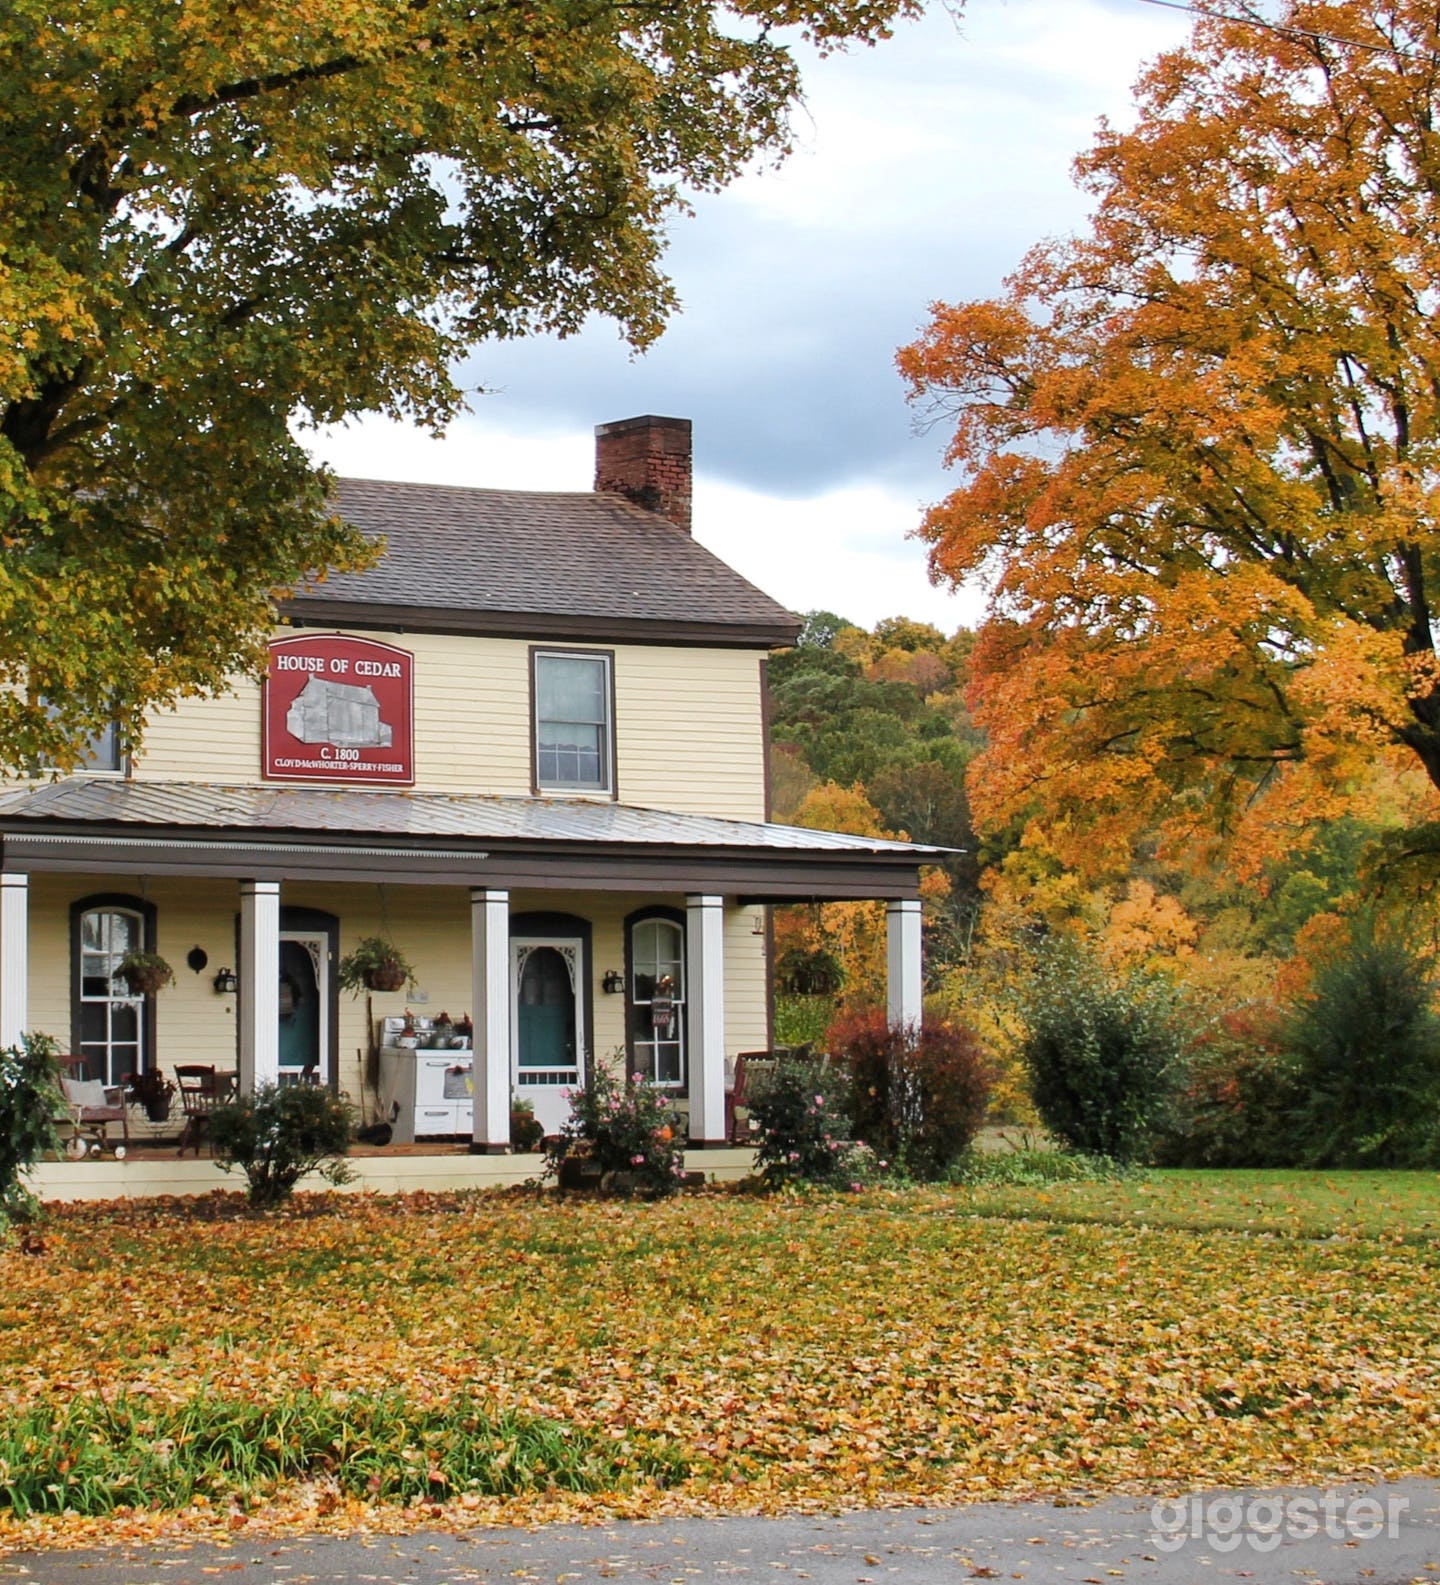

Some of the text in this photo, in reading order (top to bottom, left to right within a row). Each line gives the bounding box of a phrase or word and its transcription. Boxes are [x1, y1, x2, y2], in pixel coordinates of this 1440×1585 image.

[277, 655, 402, 677] HOUSE OF CEDAR
[320, 747, 360, 761] C. 1800
